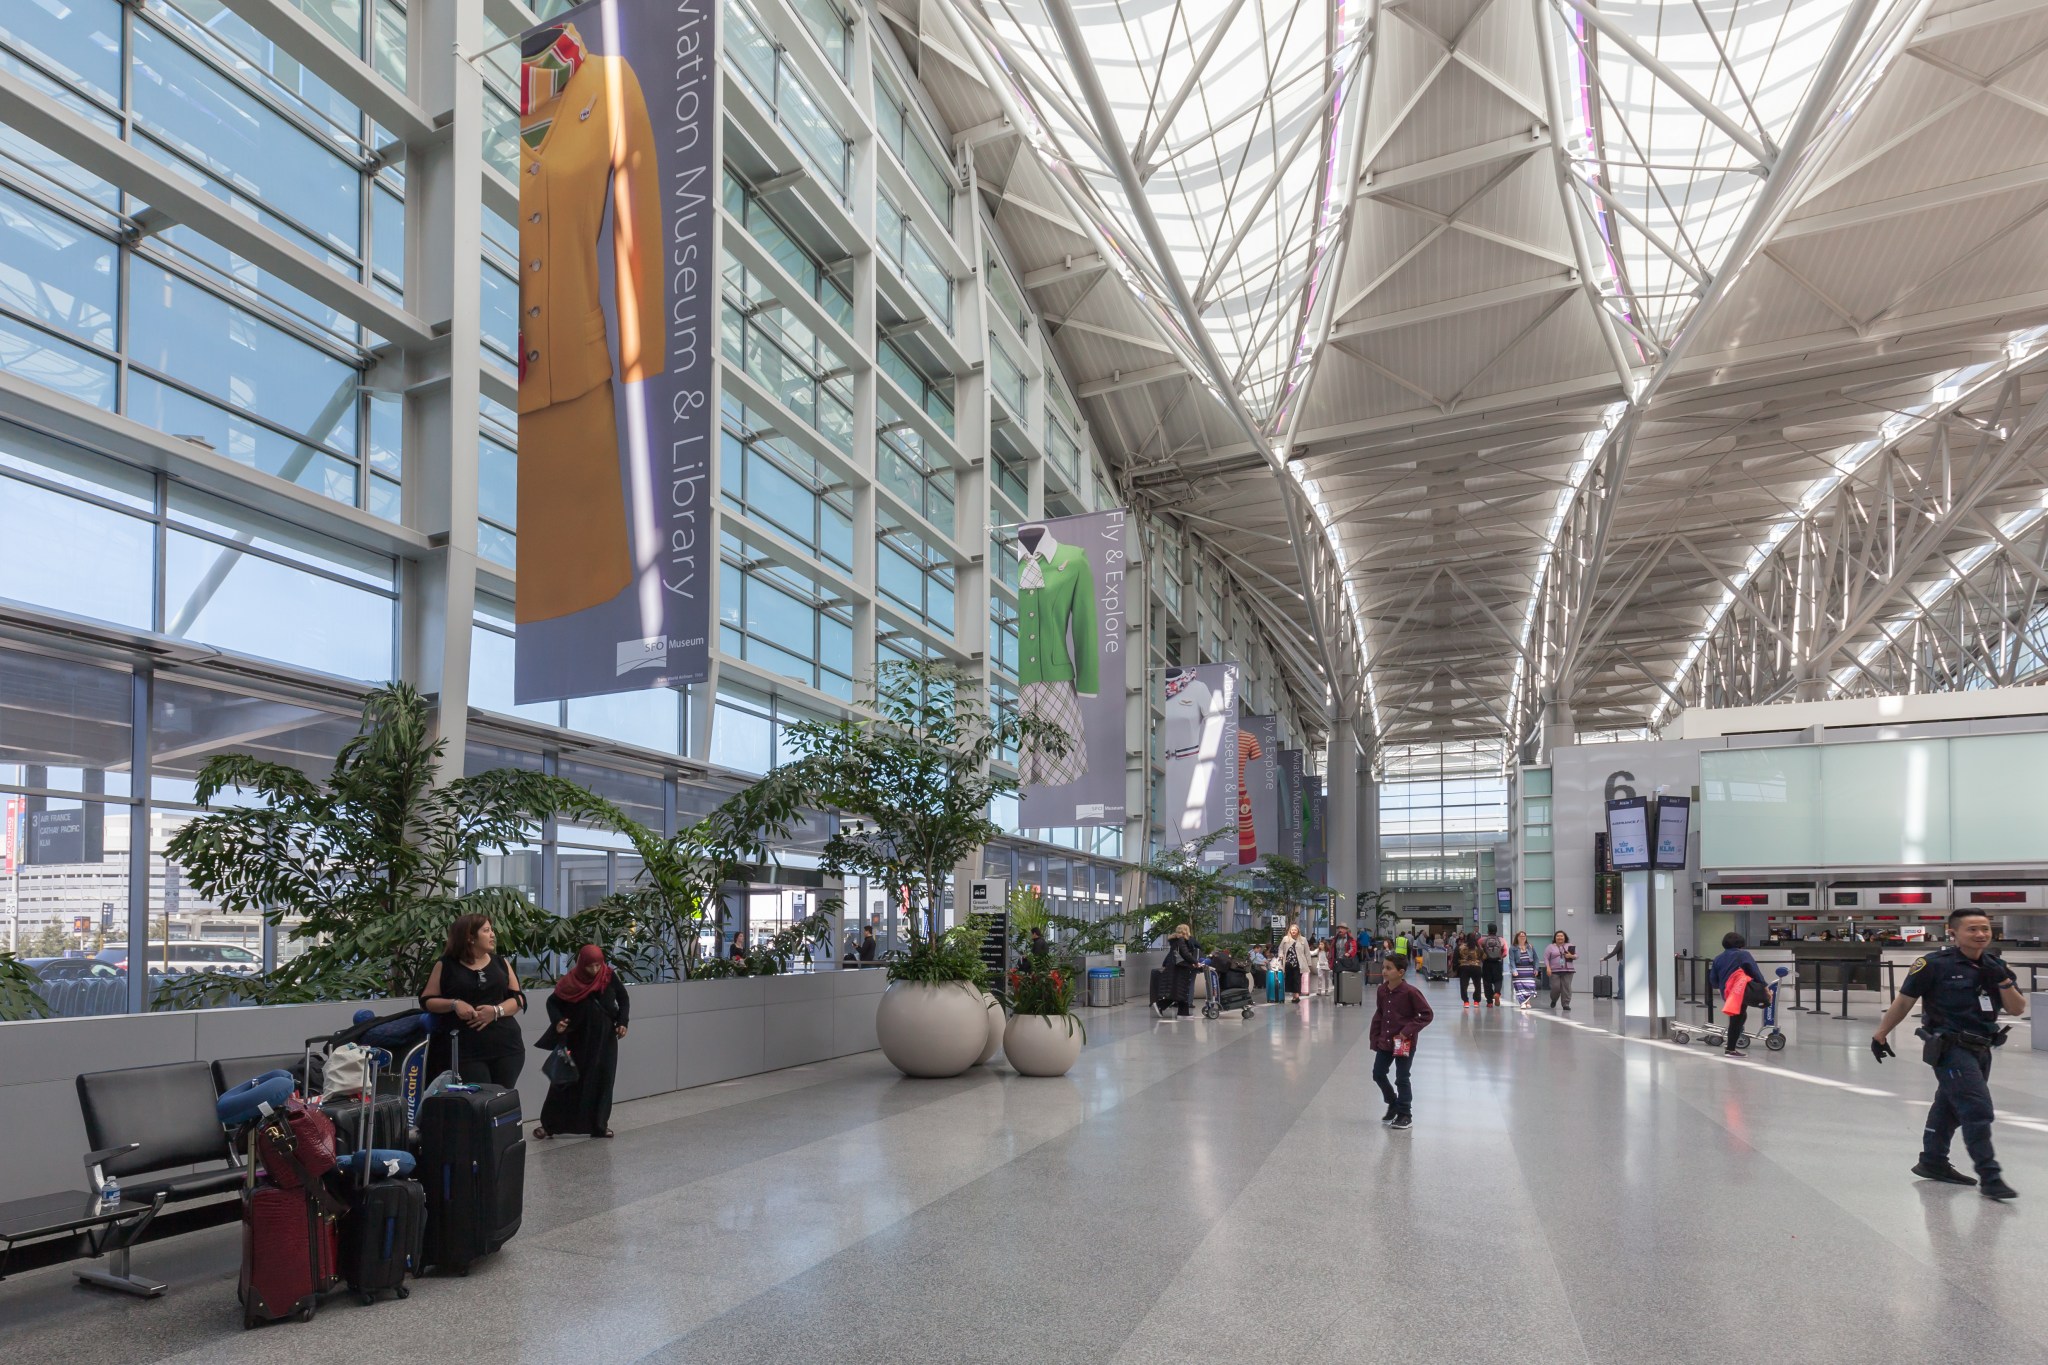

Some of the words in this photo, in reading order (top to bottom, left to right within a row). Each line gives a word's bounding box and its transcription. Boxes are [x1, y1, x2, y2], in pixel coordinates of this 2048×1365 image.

[675, 0, 707, 153] viation
[673, 165, 707, 374] Museum
[673, 390, 705, 424] &
[662, 434, 706, 599] Library
[1101, 511, 1124, 541] Fly
[1105, 549, 1124, 565] &
[1101, 570, 1124, 653] Explore
[645, 641, 664, 653] SFO
[668, 637, 704, 650] Museum
[1224, 664, 1238, 718] Aviation
[1263, 716, 1276, 732] Fly
[1265, 735, 1276, 744] &
[1224, 721, 1237, 779] Museum
[1263, 747, 1276, 790] Explore
[1292, 751, 1302, 788] Aviation
[1224, 783, 1237, 793] &
[1605, 770, 1636, 801] 6
[32, 815, 38, 827] 3
[41, 815, 50, 823] AIR
[51, 813, 71, 821] FRANCE
[1292, 790, 1302, 830] Museum
[1312, 799, 1322, 830] Explore
[40, 825, 59, 834] CATHAY
[60, 824, 80, 833] PACIFIC
[40, 839, 51, 847] KLM
[6, 905, 16, 914] 20
